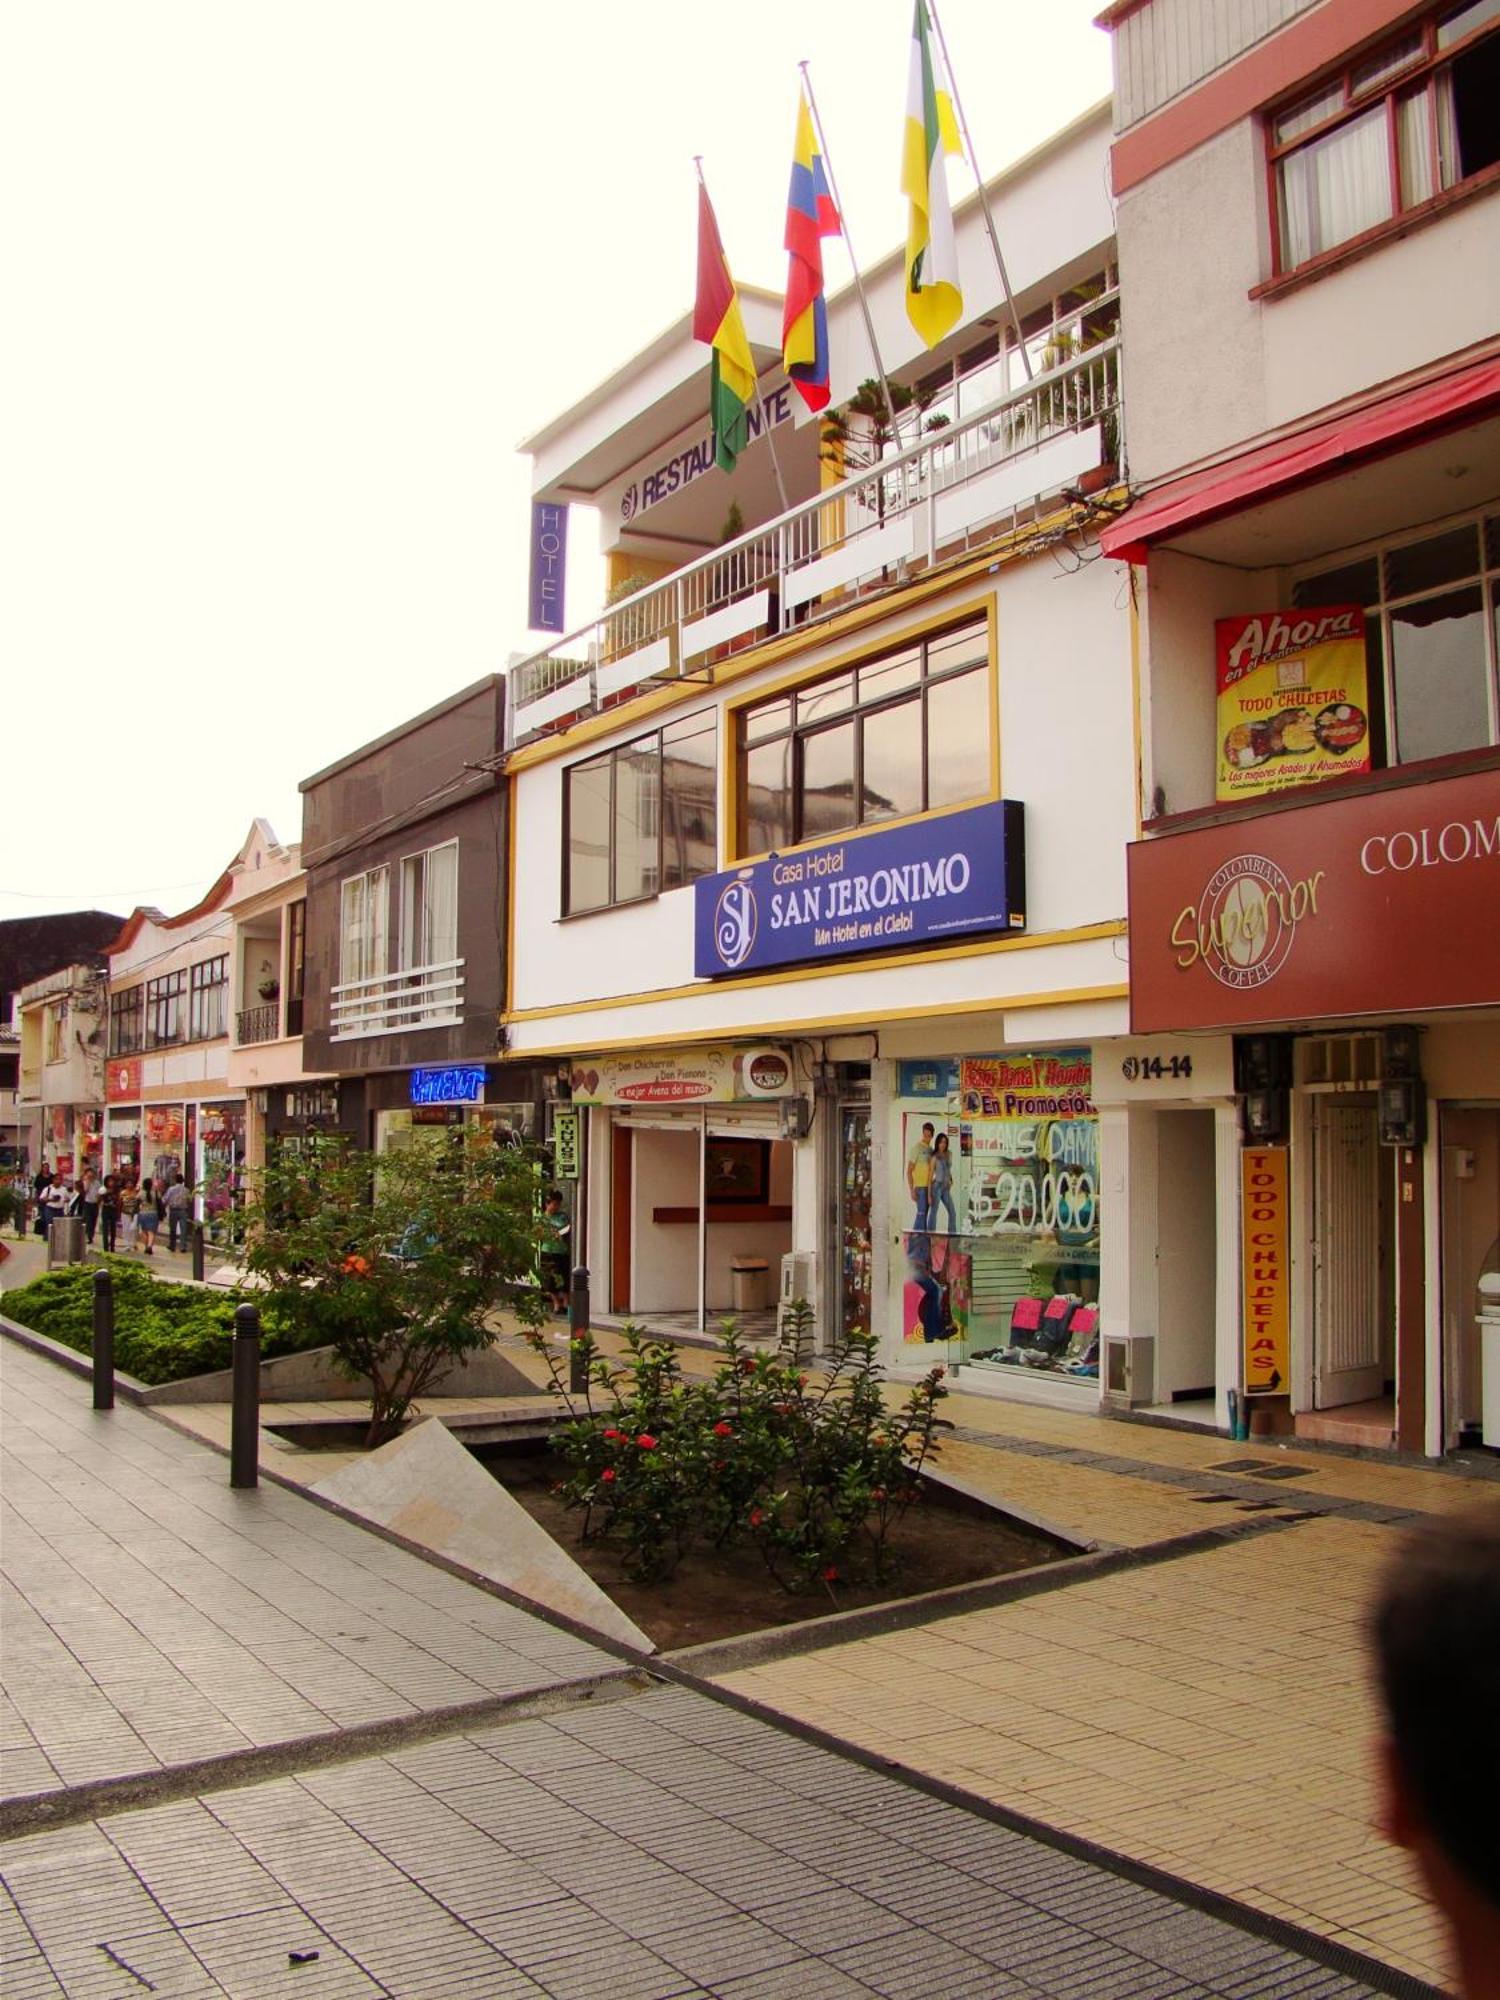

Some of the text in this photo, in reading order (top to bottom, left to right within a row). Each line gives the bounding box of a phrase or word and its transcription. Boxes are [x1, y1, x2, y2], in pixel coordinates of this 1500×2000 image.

[642, 383, 791, 510] RESTAUNTE
[540, 508, 560, 625] HOTEL
[1229, 613, 1354, 668] Ahora
[1238, 697, 1273, 713] TODO
[773, 848, 844, 886] Casa Hotel
[770, 886, 821, 929] SAN
[825, 853, 970, 919] JERONIMO
[832, 921, 858, 942] Hotel
[859, 923, 873, 938] en
[874, 916, 884, 936] el
[884, 909, 914, 933] Cielo!
[1172, 871, 1325, 967] Superior
[1219, 963, 1273, 986] COFFEE
[1140, 1055, 1192, 1079] 14-14
[982, 1095, 1001, 1115] En
[1247, 1156, 1279, 1369] TODO CHULETAS
